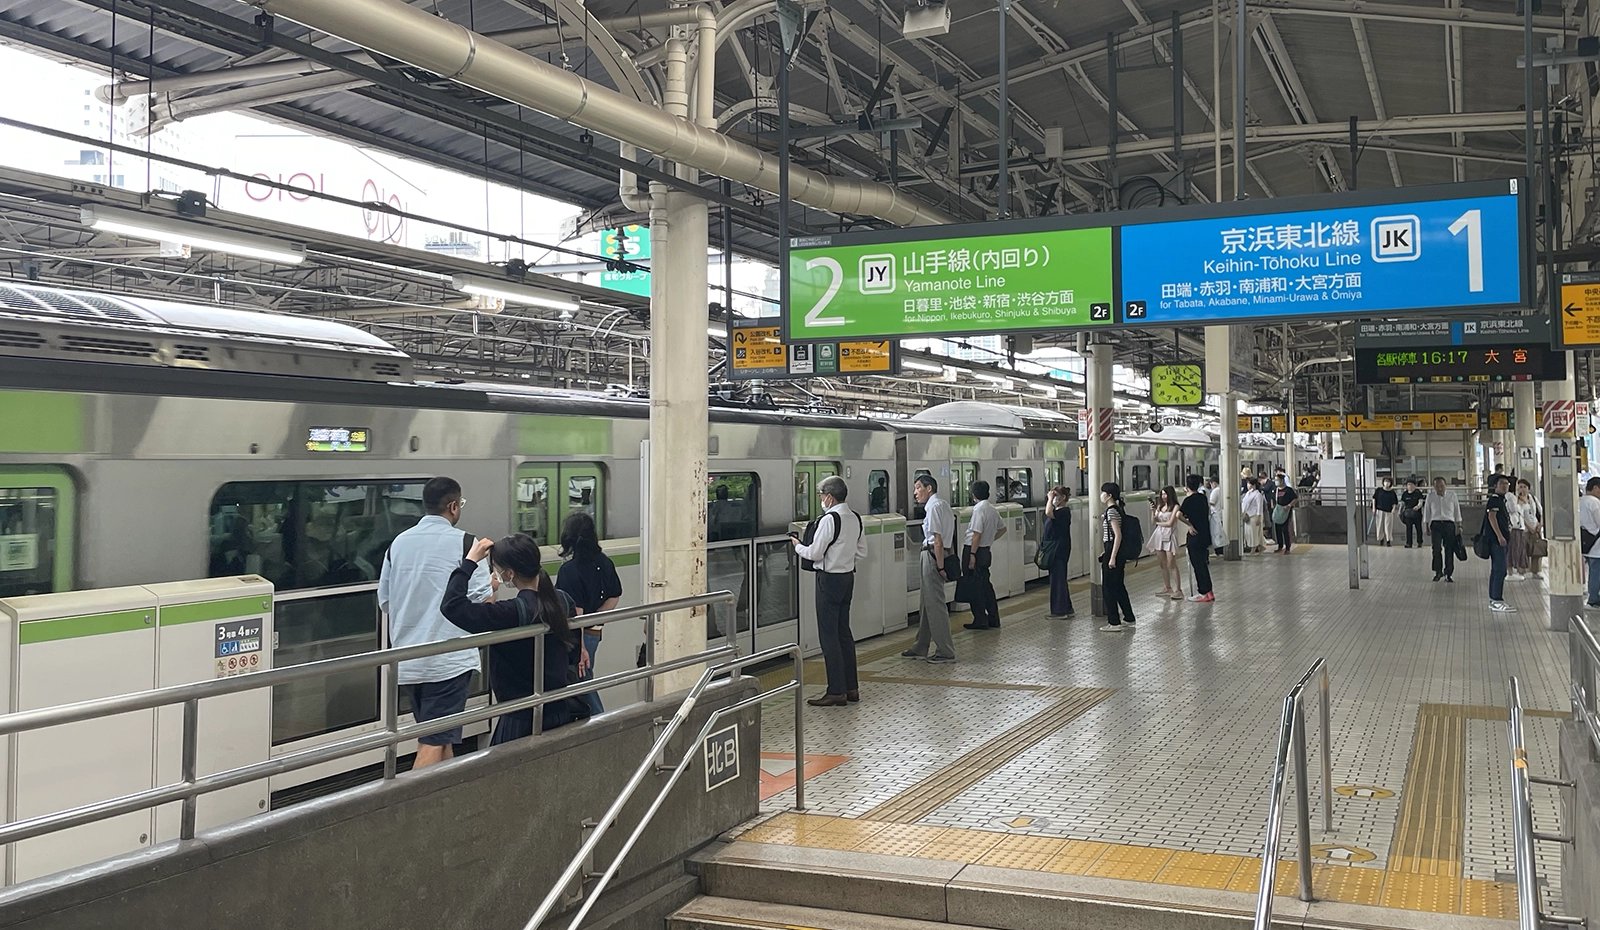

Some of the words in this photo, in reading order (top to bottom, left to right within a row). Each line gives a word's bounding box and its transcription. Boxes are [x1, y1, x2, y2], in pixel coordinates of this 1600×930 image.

[1220, 219, 1361, 255] 京浜東北線
[1382, 229, 1409, 249] JK
[903, 246, 1050, 275] 山手線(内回り)
[1447, 209, 1484, 293] 1
[1203, 255, 1320, 274] Keihin-Tōhoku
[1325, 252, 1361, 267] Line
[867, 266, 888, 282] JY
[805, 256, 845, 327] 2
[904, 277, 972, 293] Yamanote
[976, 275, 1006, 288] Line
[1161, 272, 1362, 299] 田端・赤羽・南浦和・大宮方面
[904, 290, 1074, 313] 日暮里・池袋・新宿・渋谷方面
[1160, 300, 1171, 309] for
[1173, 299, 1205, 309] Tabata,
[1208, 296, 1250, 307] Akabane,
[1253, 292, 1319, 304] Minami-Urawa
[1321, 291, 1328, 300] &
[995, 308, 1031, 319] Shinjuku
[1033, 308, 1039, 316] &
[1042, 306, 1077, 315] Shibuya
[1092, 305, 1108, 318] 2F
[1129, 303, 1144, 317] 2F
[1480, 320, 1524, 329] 京浜東北線
[1376, 352, 1418, 367] 各駅停車
[1422, 351, 1468, 365] 16:17
[708, 738, 736, 776] 北B
